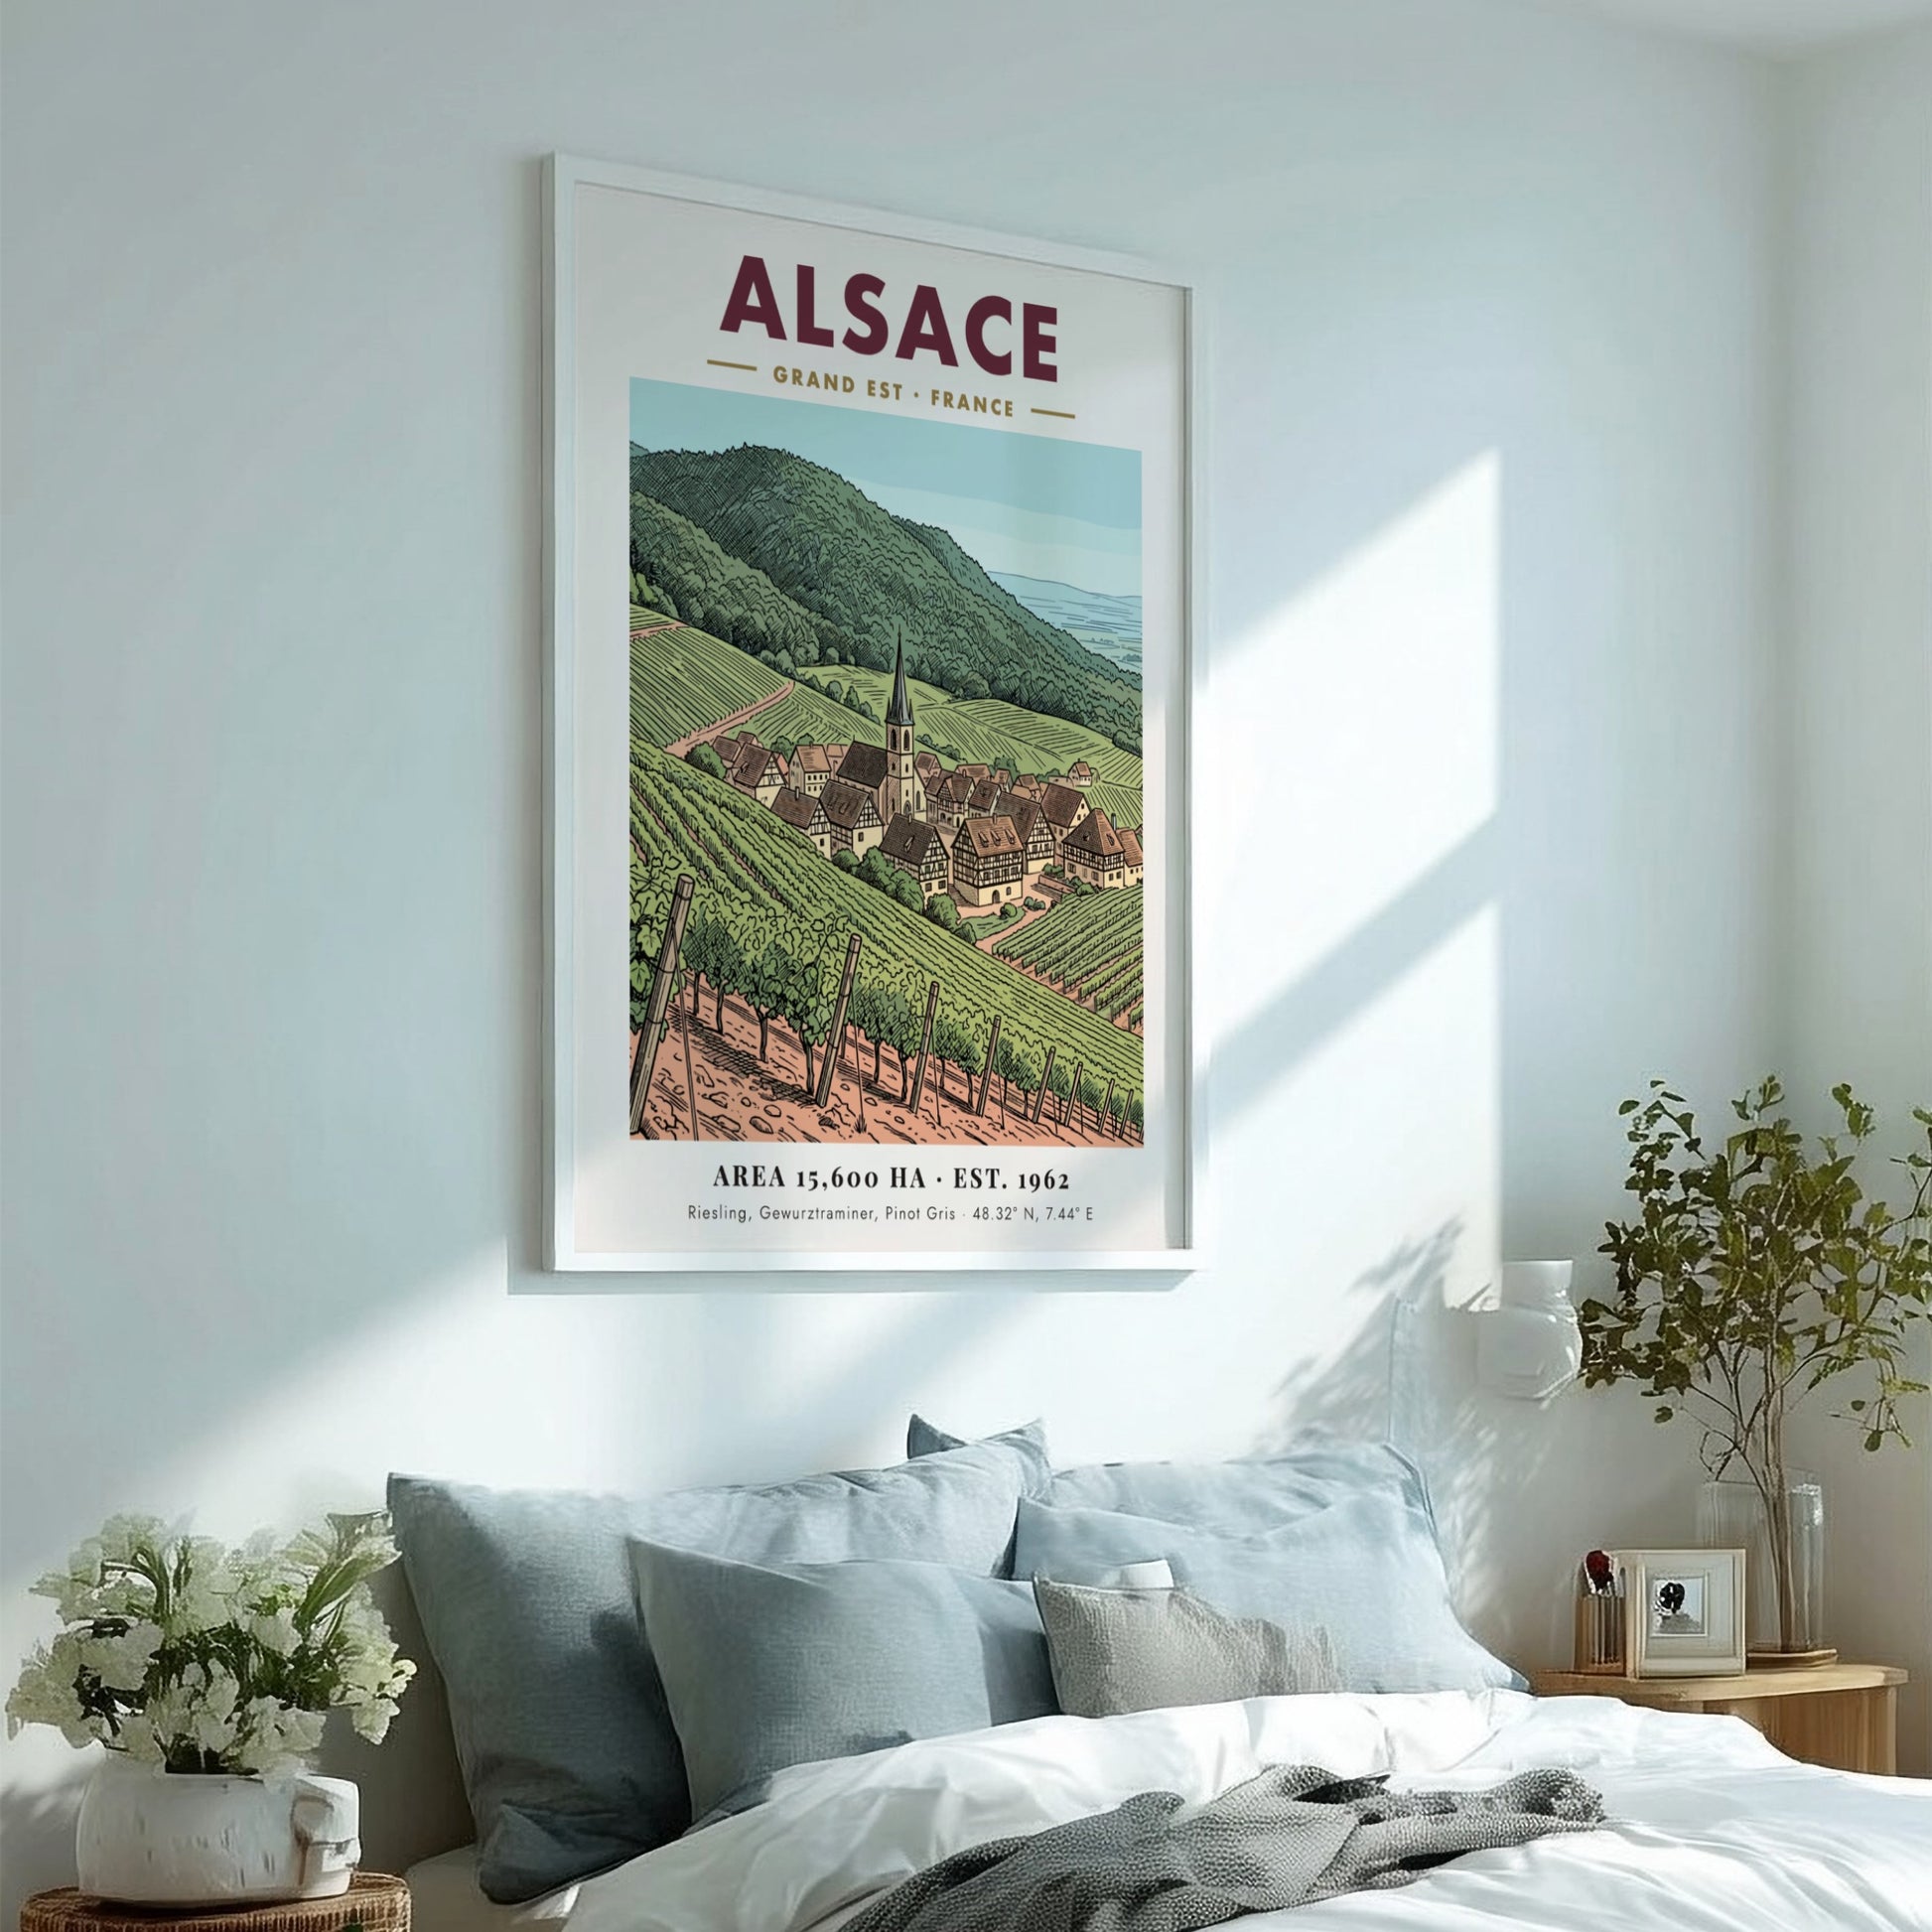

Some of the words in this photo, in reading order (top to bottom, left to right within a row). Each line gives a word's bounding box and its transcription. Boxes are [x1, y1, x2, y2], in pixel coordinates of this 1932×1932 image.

[720, 254, 1057, 383] ALSACE
[772, 365, 855, 393] GRAND
[867, 380, 902, 401] EST
[931, 389, 1014, 418] FRANCE
[713, 1165, 785, 1187] AREA
[796, 1166, 879, 1191] 15,600
[891, 1167, 925, 1189] HA
[953, 1168, 1008, 1189] EST.
[1019, 1169, 1069, 1193] 1962
[688, 1204, 753, 1224] Riesling,
[759, 1205, 879, 1223] Gewurztraminer,
[886, 1205, 920, 1220] Pinot
[926, 1205, 955, 1220] Gris
[1024, 1206, 1039, 1223] N,
[1086, 1207, 1093, 1220] E
